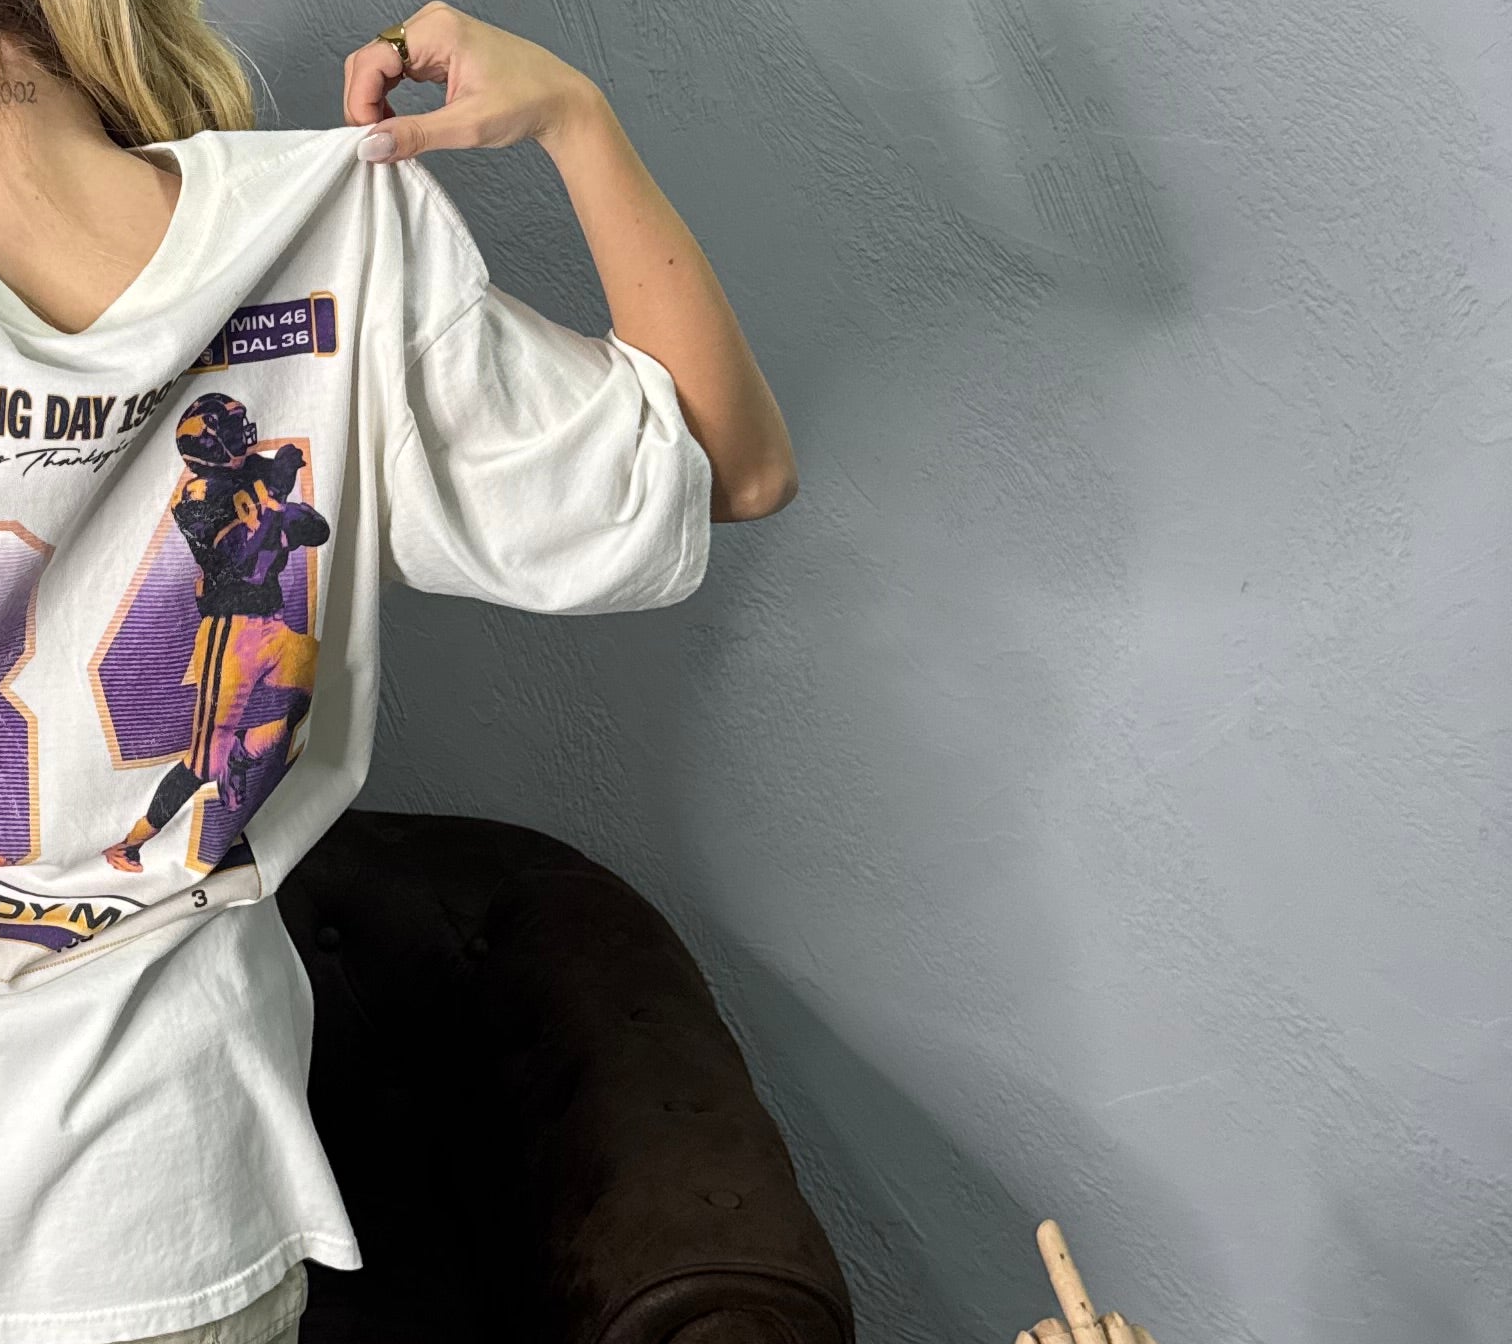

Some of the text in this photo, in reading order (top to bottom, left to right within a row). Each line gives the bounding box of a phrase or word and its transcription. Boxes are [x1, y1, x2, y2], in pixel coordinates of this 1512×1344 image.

[230, 308, 307, 333] MIN 46
[232, 330, 310, 355] DAL 36
[43, 394, 117, 442] DAY
[191, 889, 208, 908] 3
